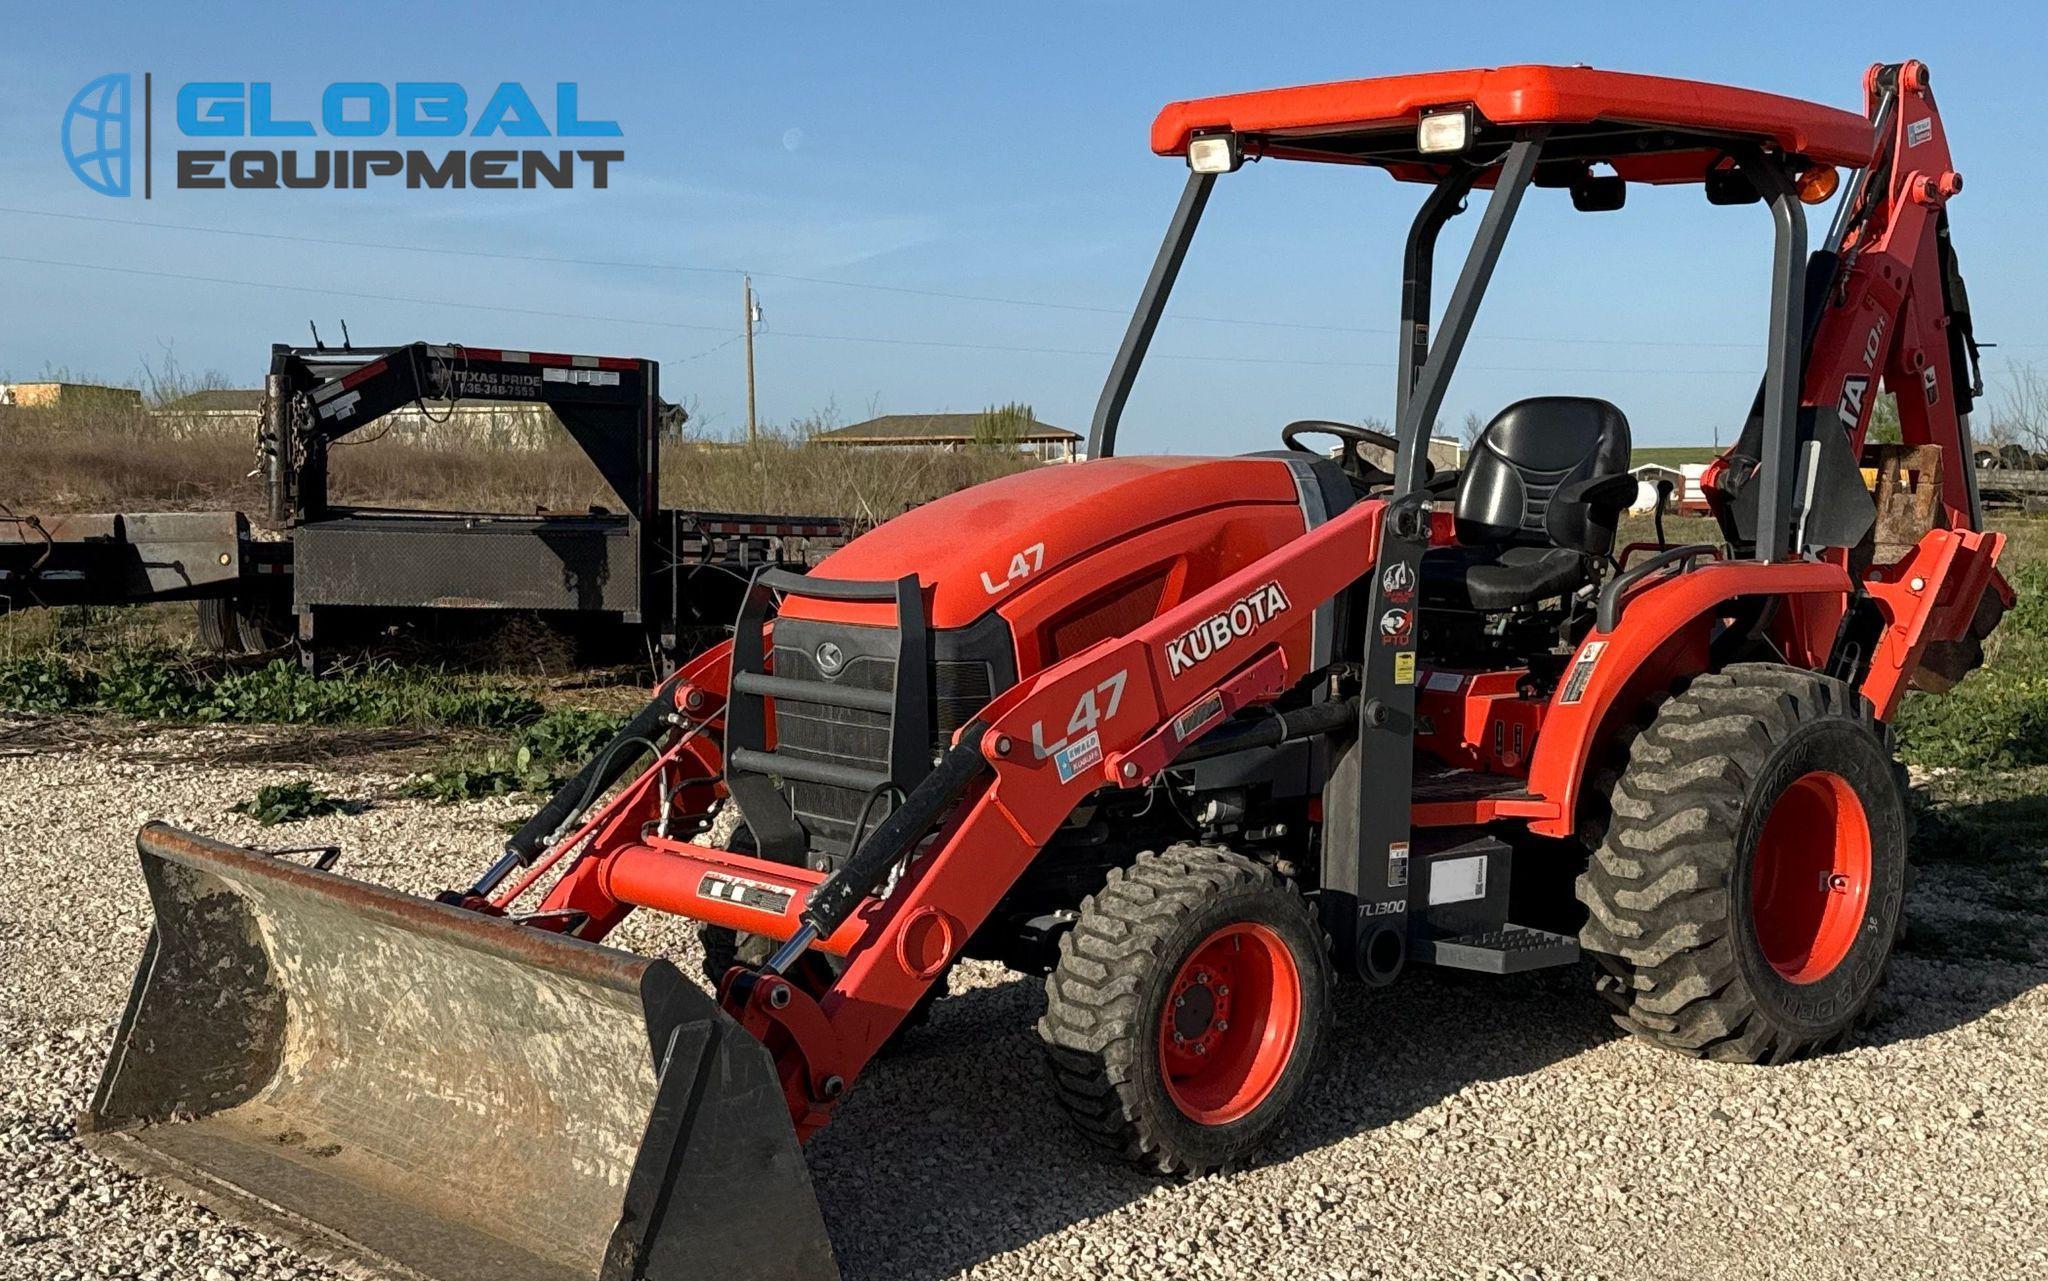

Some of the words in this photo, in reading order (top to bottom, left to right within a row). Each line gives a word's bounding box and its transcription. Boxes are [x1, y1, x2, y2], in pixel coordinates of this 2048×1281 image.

[453, 370, 498, 384] TEXAS
[501, 374, 542, 387] PRIDE
[1167, 583, 1288, 678] KUBOTA
[1383, 635, 1409, 646] PTO
[1360, 900, 1407, 918] TL1300
